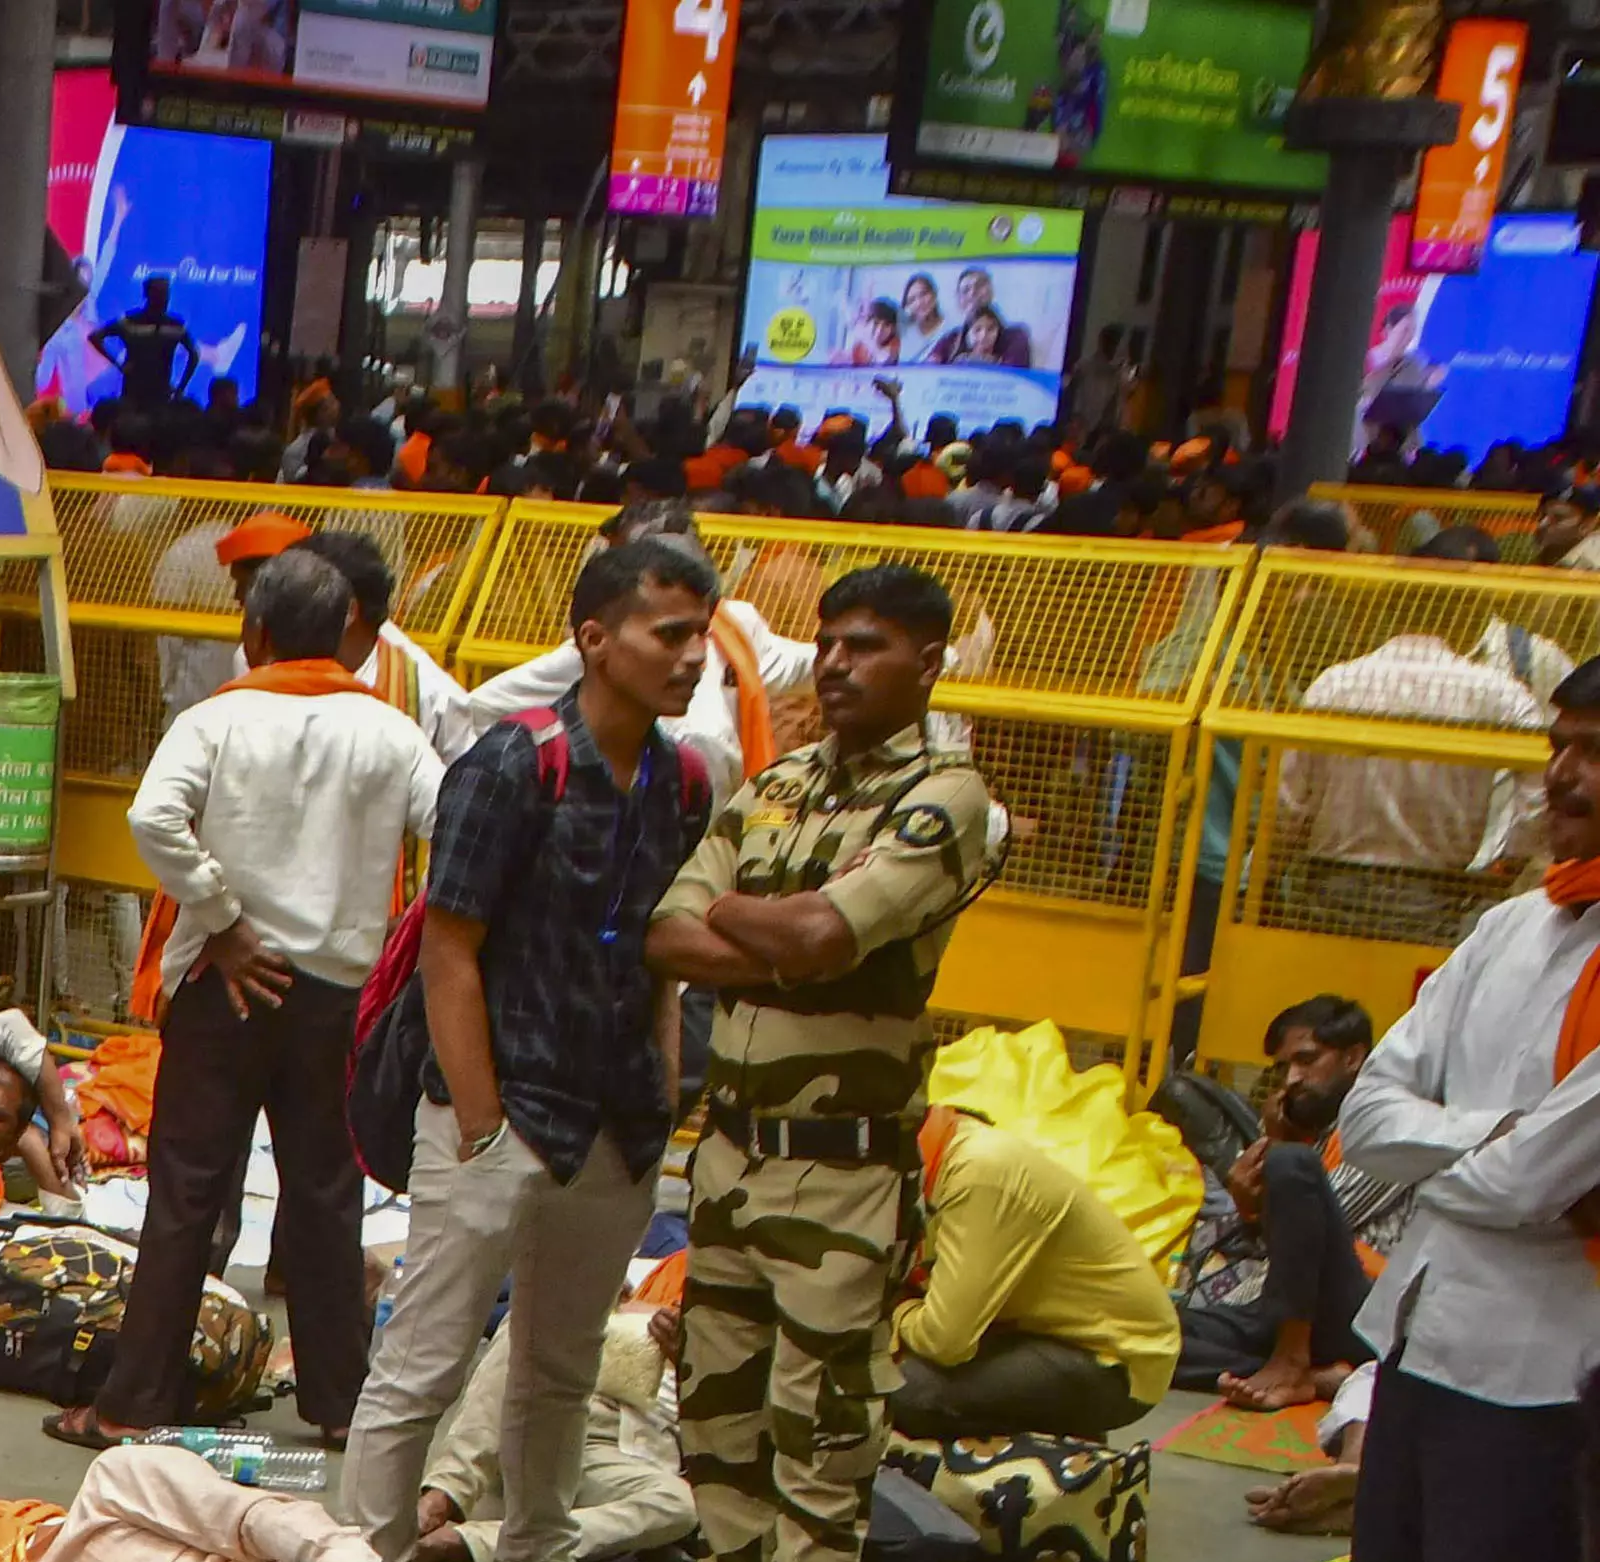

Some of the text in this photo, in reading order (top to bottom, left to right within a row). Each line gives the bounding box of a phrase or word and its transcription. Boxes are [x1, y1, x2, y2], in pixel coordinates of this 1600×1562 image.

[673, 0, 728, 64] 4
[1470, 44, 1519, 149] 5
[23, 813, 48, 831] WA
